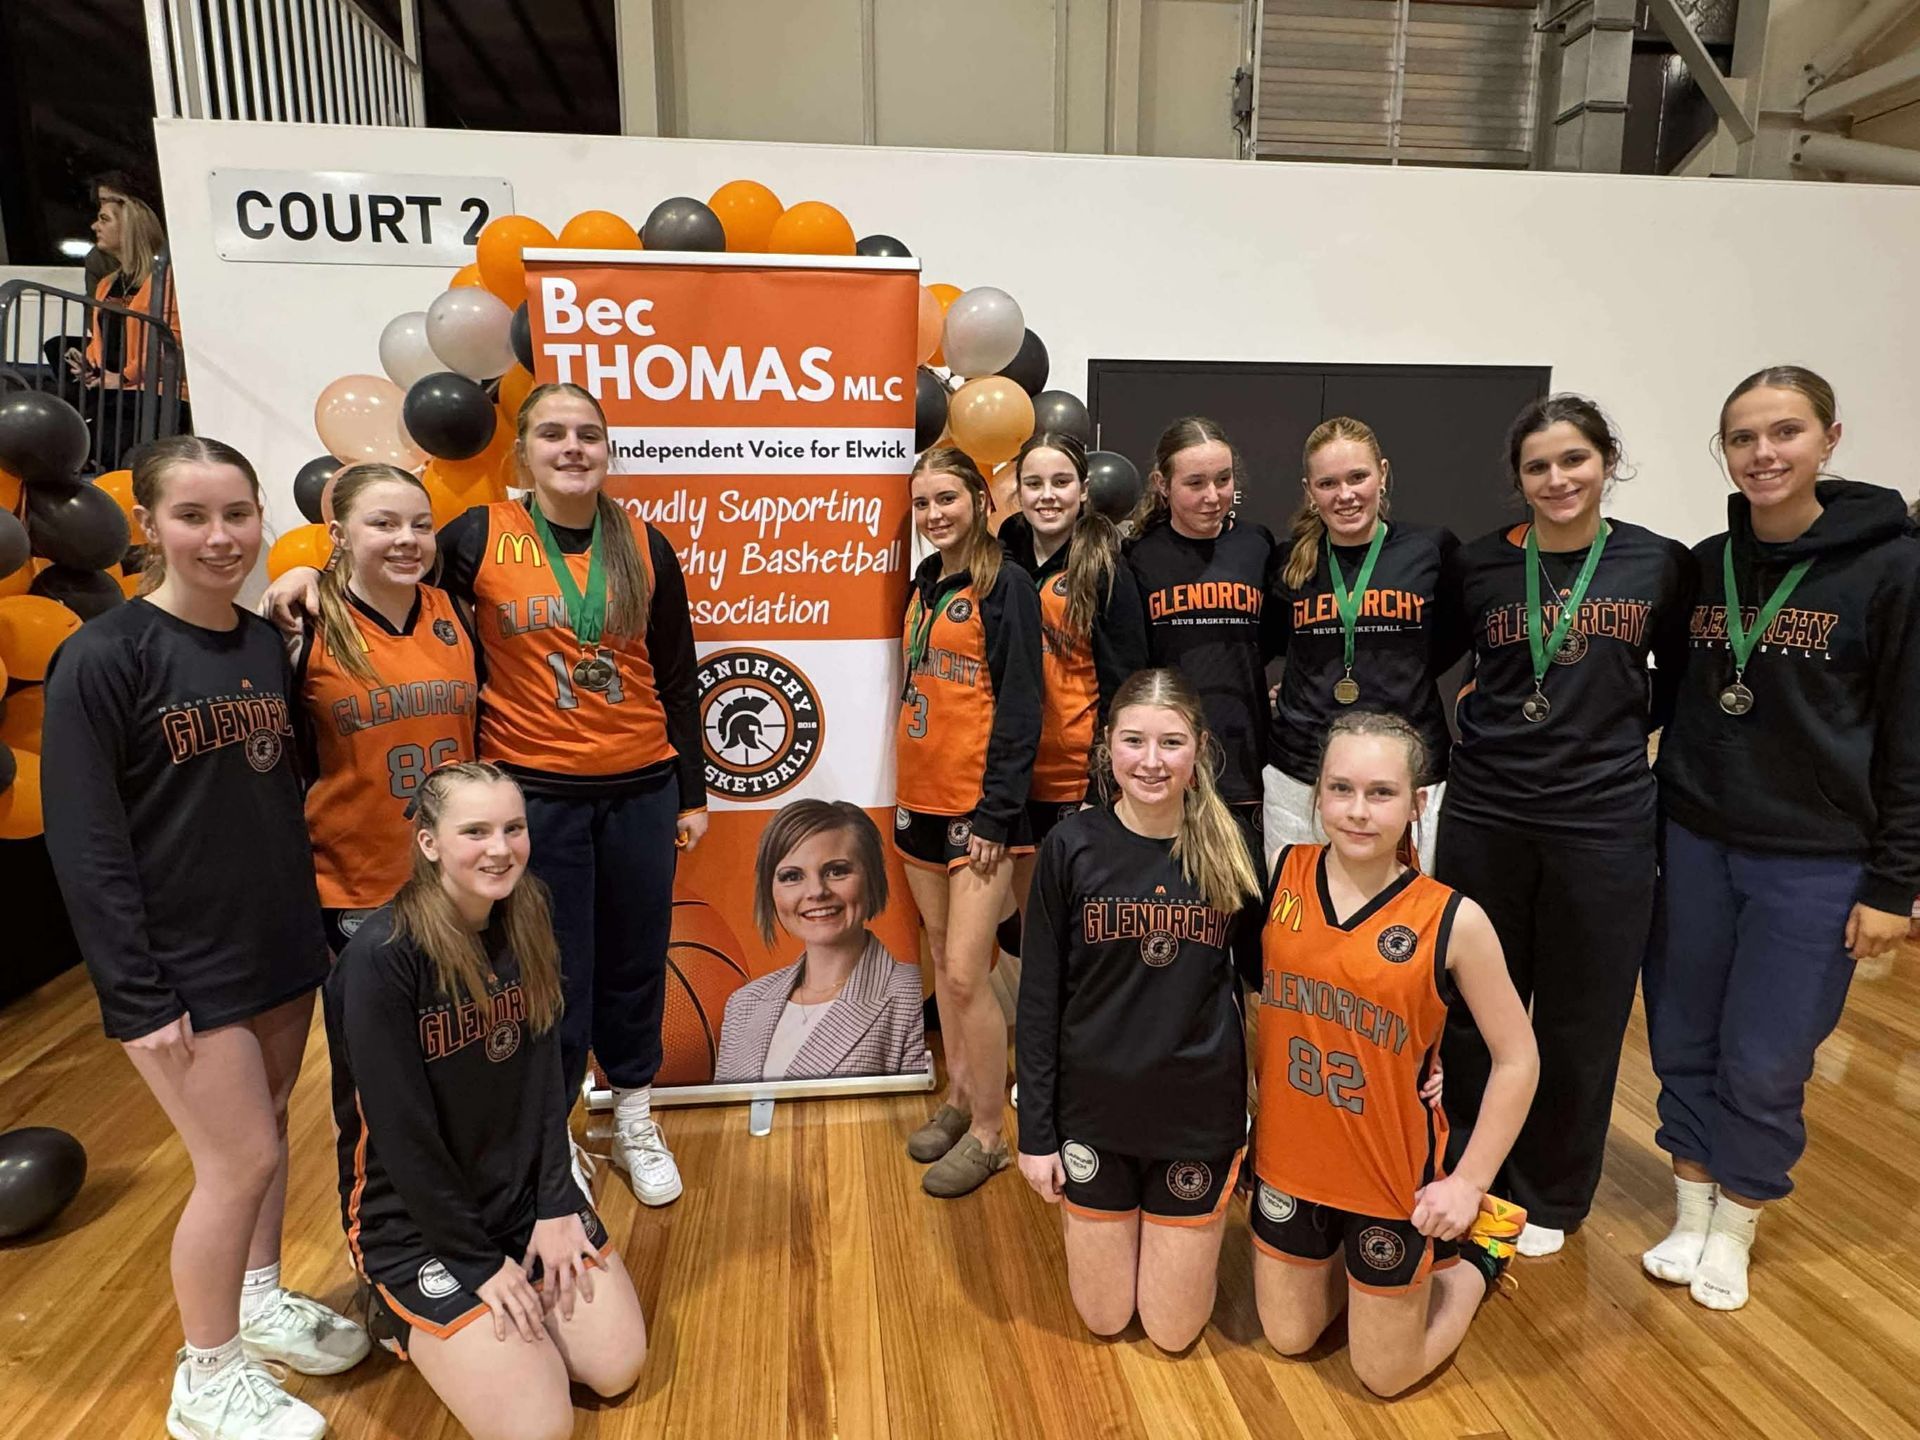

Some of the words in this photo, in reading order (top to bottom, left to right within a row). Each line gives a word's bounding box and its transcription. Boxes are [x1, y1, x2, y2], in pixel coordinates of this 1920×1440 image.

[236, 190, 442, 244] COURT
[460, 198, 490, 245] 2
[541, 277, 656, 336] Bec
[543, 343, 835, 402] THOMAS
[843, 376, 903, 402] MLC
[611, 440, 744, 462] Independent
[748, 440, 805, 458] Voice
[810, 440, 840, 458] for
[846, 440, 907, 458] Elwick
[718, 490, 882, 538] Supporting
[739, 540, 902, 577] Basketball
[1149, 582, 1264, 620] GLENORCHY
[1313, 627, 1337, 635] REVS
[332, 680, 478, 737] GLENORCH
[698, 658, 812, 712] ENORCHY
[907, 694, 928, 738] 3
[704, 739, 812, 792] SKETBALL
[1083, 902, 1235, 949] GLENORCHY
[1288, 1035, 1366, 1115] 82
